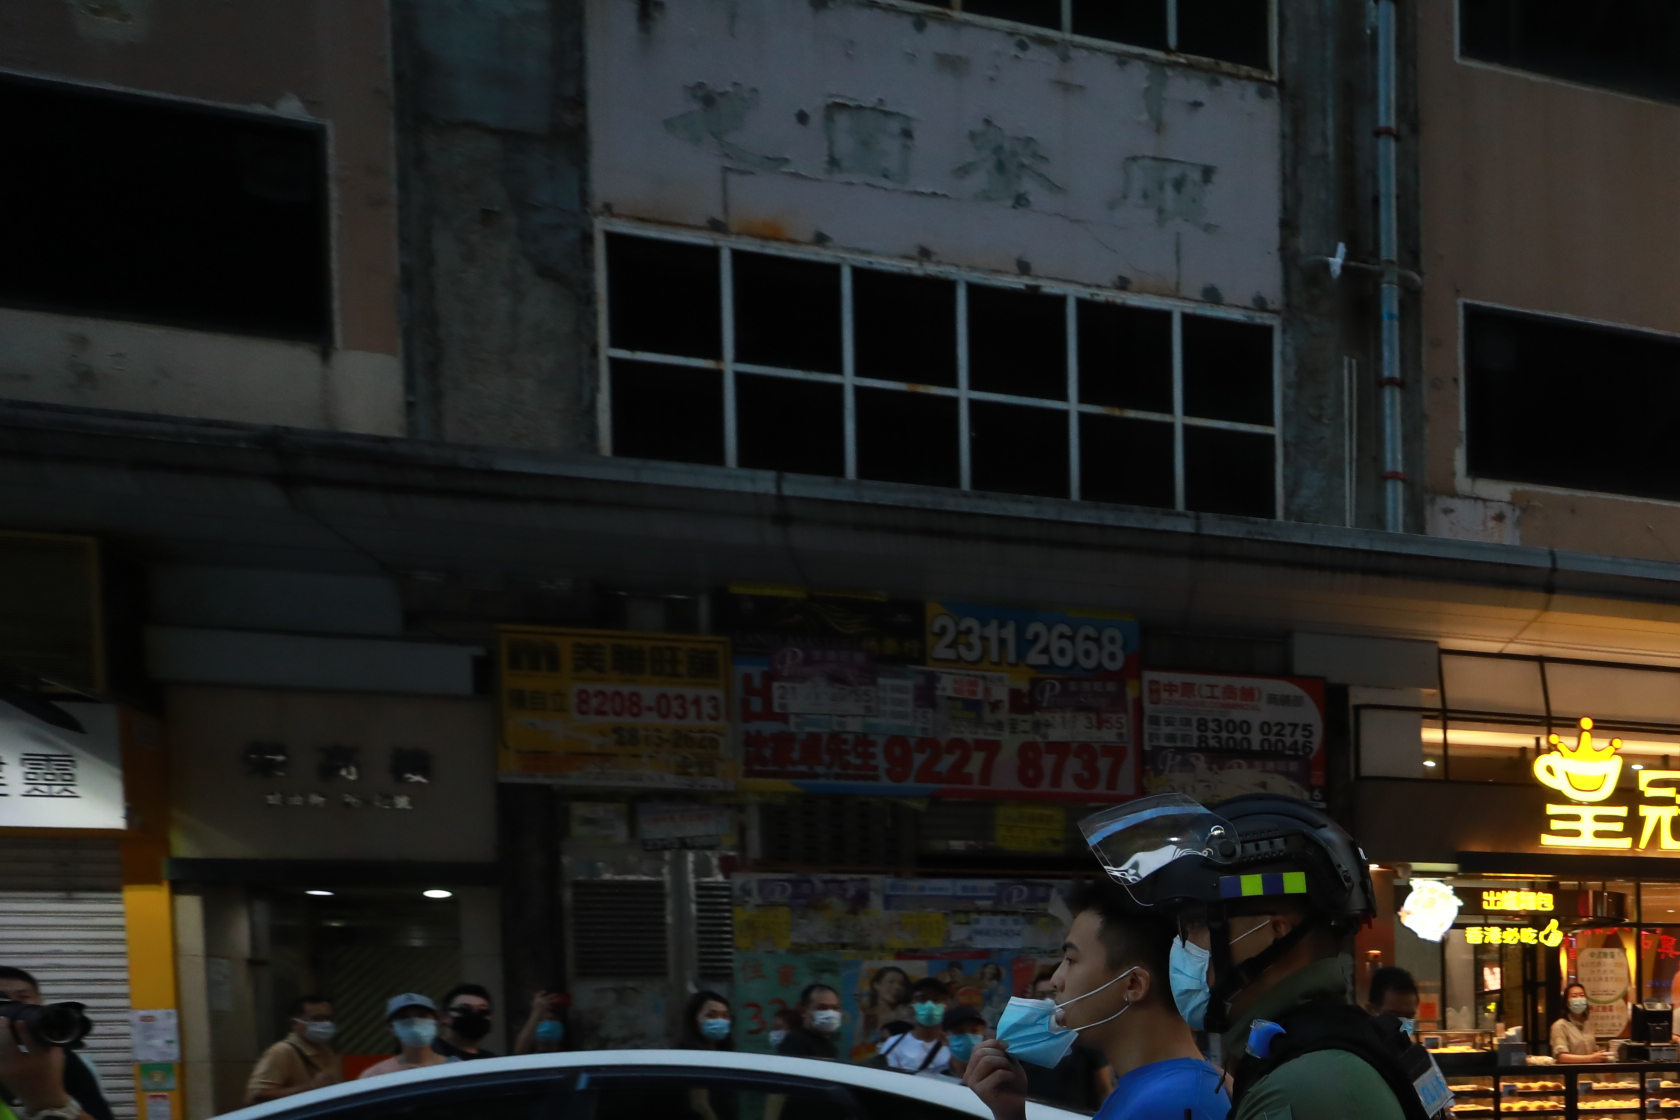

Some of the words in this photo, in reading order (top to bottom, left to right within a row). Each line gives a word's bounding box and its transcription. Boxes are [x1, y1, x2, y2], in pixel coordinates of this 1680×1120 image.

[932, 614, 1017, 664] 2311
[1025, 621, 1126, 671] 2668
[576, 689, 724, 721] 8208-0313
[1196, 717, 1252, 735] 8300
[1260, 721, 1313, 739] 0275
[0, 754, 81, 798] 靈
[883, 735, 1001, 786] 9227
[1017, 741, 1128, 791] 8737
[1465, 926, 1539, 945] 香港必吃
